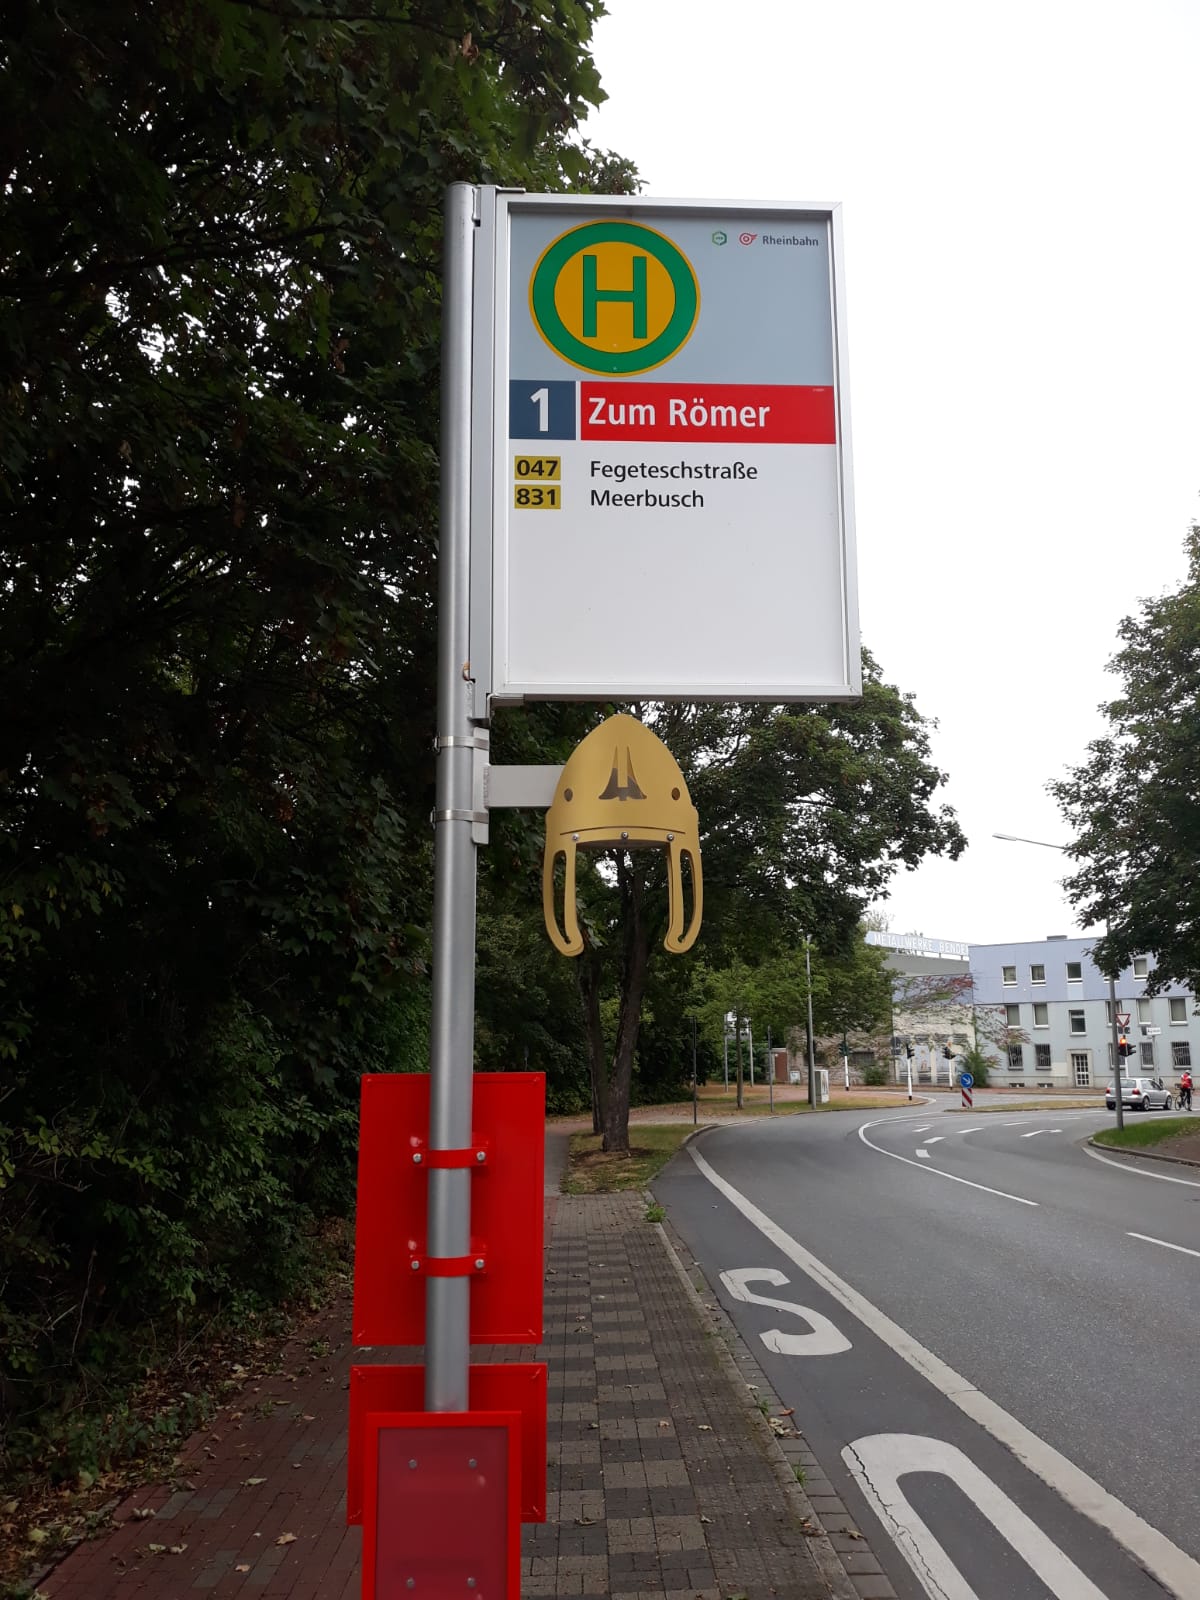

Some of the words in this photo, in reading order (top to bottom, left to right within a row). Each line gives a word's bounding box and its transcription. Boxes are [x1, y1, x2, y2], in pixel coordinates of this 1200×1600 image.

[762, 235, 819, 246] Rheinbahn
[582, 254, 648, 339] H
[529, 387, 551, 432] 1
[588, 396, 656, 428] Zum
[668, 397, 771, 429] Römer
[516, 459, 559, 477] 047
[590, 460, 758, 482] Fegeteschstraße
[516, 488, 558, 506] 831
[590, 490, 704, 508] Meerbusch
